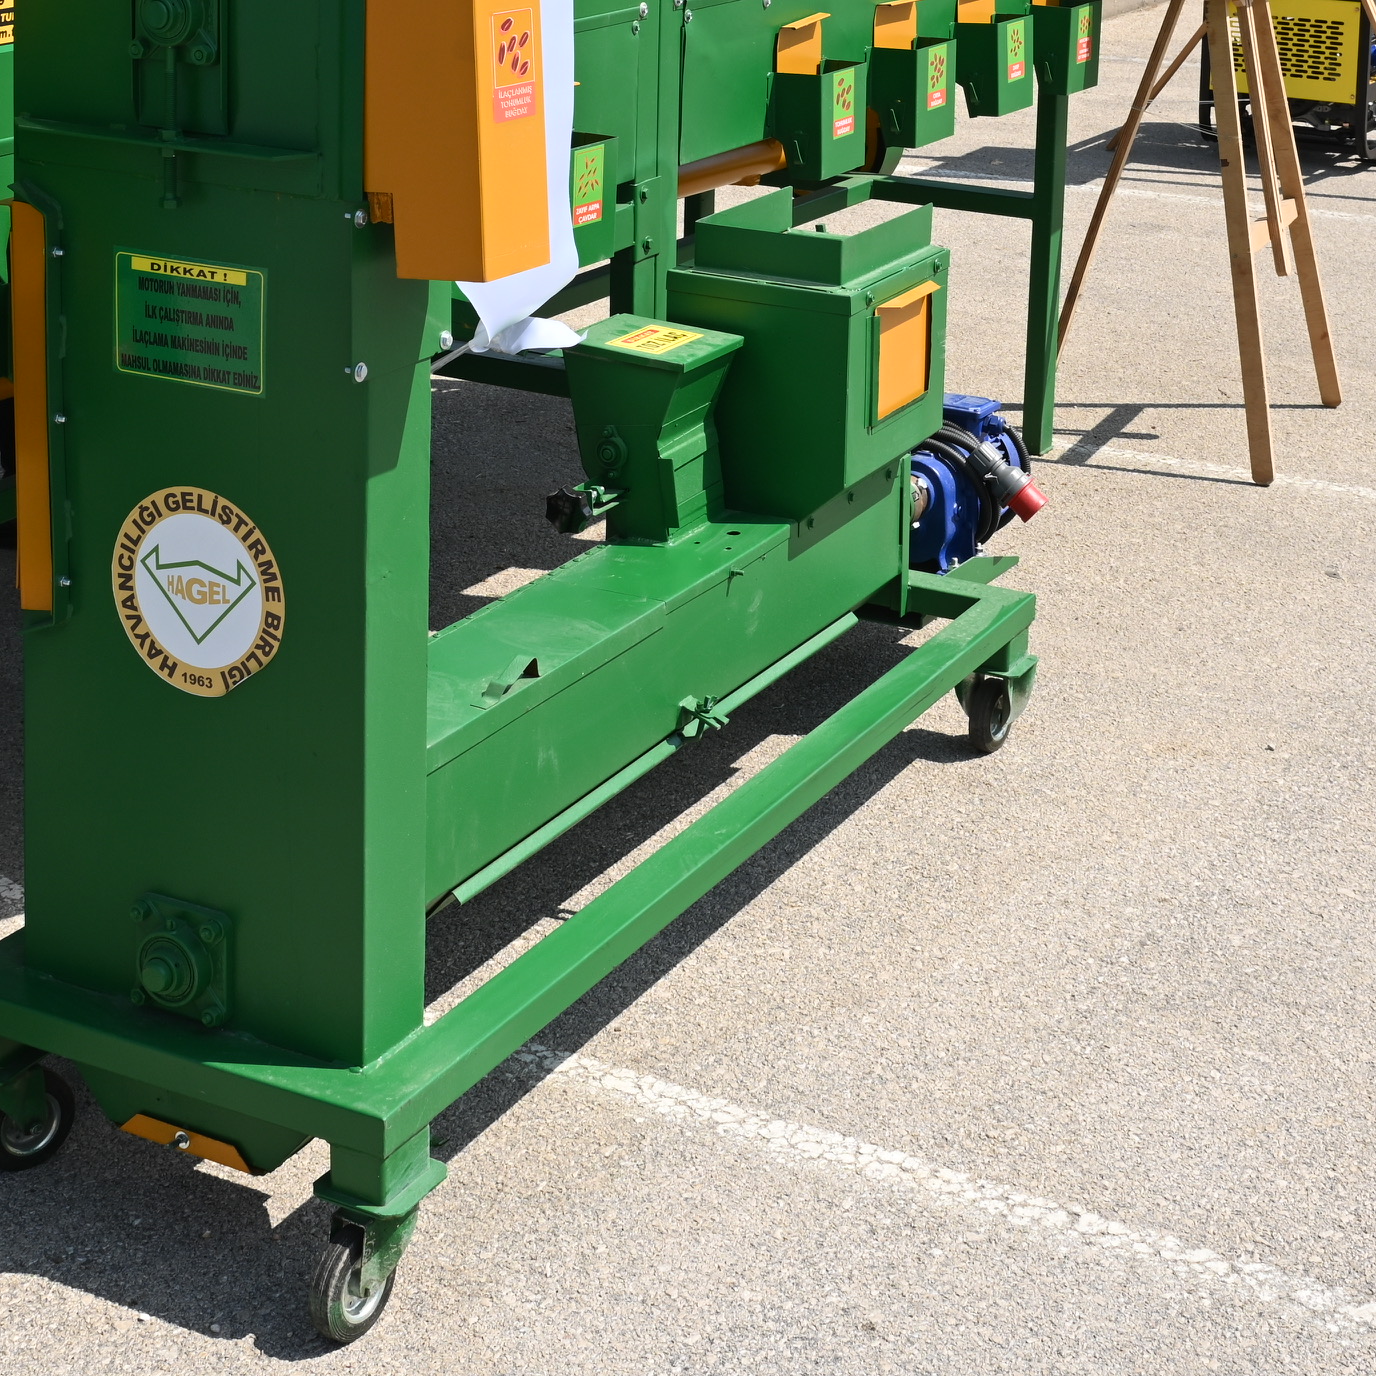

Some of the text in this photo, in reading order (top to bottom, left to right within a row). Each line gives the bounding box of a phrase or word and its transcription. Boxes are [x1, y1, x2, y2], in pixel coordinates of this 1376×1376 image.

[498, 85, 533, 99] İLAÇLANMIŞ
[500, 96, 532, 109] TOHUMLUK
[505, 106, 528, 119] BUĞDAY
[576, 202, 600, 216] ZAYIF ARPA
[578, 212, 598, 224] ÇAVDAR
[150, 262, 218, 280] DİKKAT
[138, 276, 174, 295] MOTORUN
[176, 281, 221, 302] YANMAMASI
[144, 300, 234, 332] İLK ÇALIŞTIRMA ANINDA
[132, 326, 248, 361] İLAÇLAMA MAKİNESİNİN İÇİNDE
[122, 353, 261, 390] MAHSUL OLMAMASINA DİKKAT EDİNİZ.
[118, 499, 178, 679] HAYVANCILIĞI
[164, 491, 282, 603] GELİŞTİRME
[167, 574, 230, 605] HAGEL
[181, 672, 214, 689] 1963
